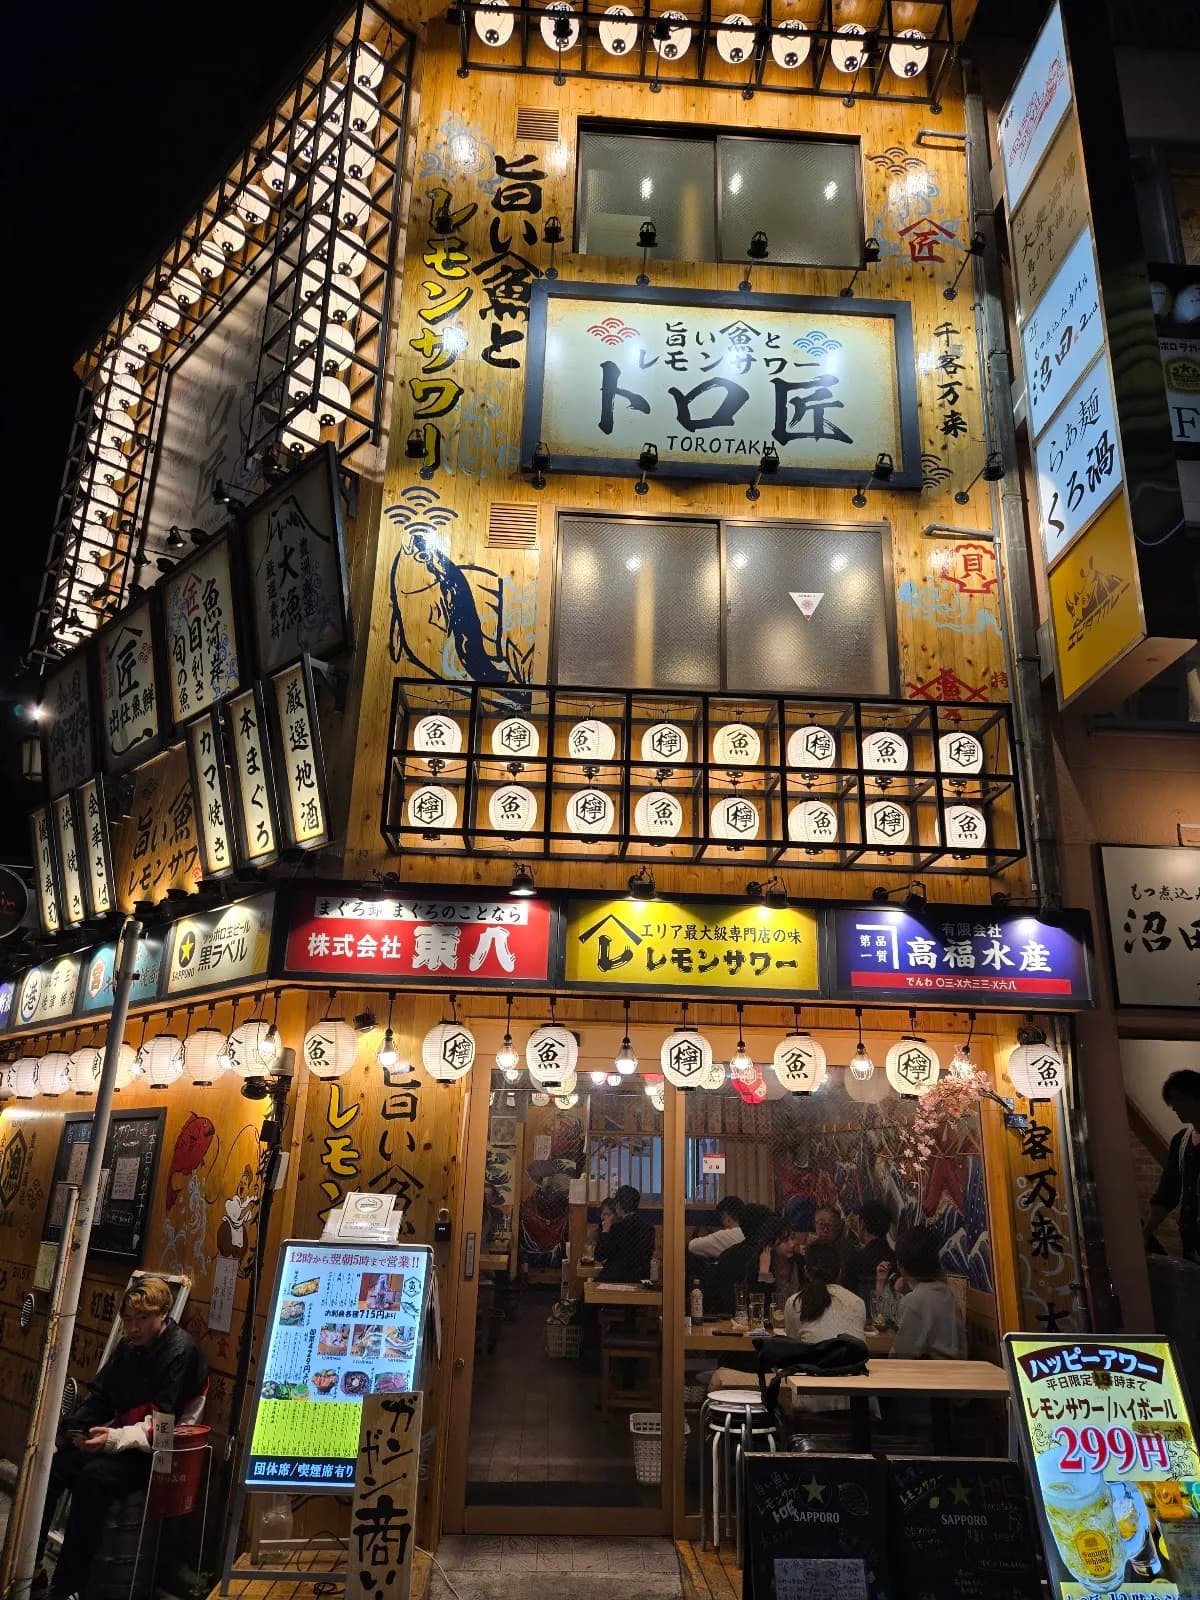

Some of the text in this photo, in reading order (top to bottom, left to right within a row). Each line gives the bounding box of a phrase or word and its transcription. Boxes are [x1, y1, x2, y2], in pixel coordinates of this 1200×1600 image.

[472, 155, 547, 369] 旨い魚と
[664, 319, 783, 352] 旨い魚と
[639, 348, 821, 376] レモンサワー
[933, 322, 968, 438] 千客万来
[598, 360, 854, 446] トロ匠
[666, 435, 778, 457] TOROTAKU
[961, 554, 988, 581] 貝
[286, 678, 320, 832] 厳選地酒
[239, 706, 270, 849] 本まぐろ
[199, 731, 225, 861] カマ焼き
[392, 902, 522, 924] まぐろのことなら
[307, 932, 402, 960] 株式会社
[640, 923, 803, 945] エリア最大級専門店の味
[941, 923, 1003, 939] 有限会社
[198, 937, 248, 972] 黒ラベル
[646, 947, 800, 976] レモンサワー
[906, 936, 1053, 973] 高福水産
[906, 976, 933, 988] でんわ
[1021, 1099, 1064, 1260] 客万来
[1029, 1346, 1158, 1378] ハッピーアワー
[1055, 1425, 1170, 1472] 299円
[253, 1461, 354, 1478] 団体席/喫煙席有り
[793, 1511, 840, 1523] SAPPORO
[940, 1514, 988, 1526] SAPPORO
